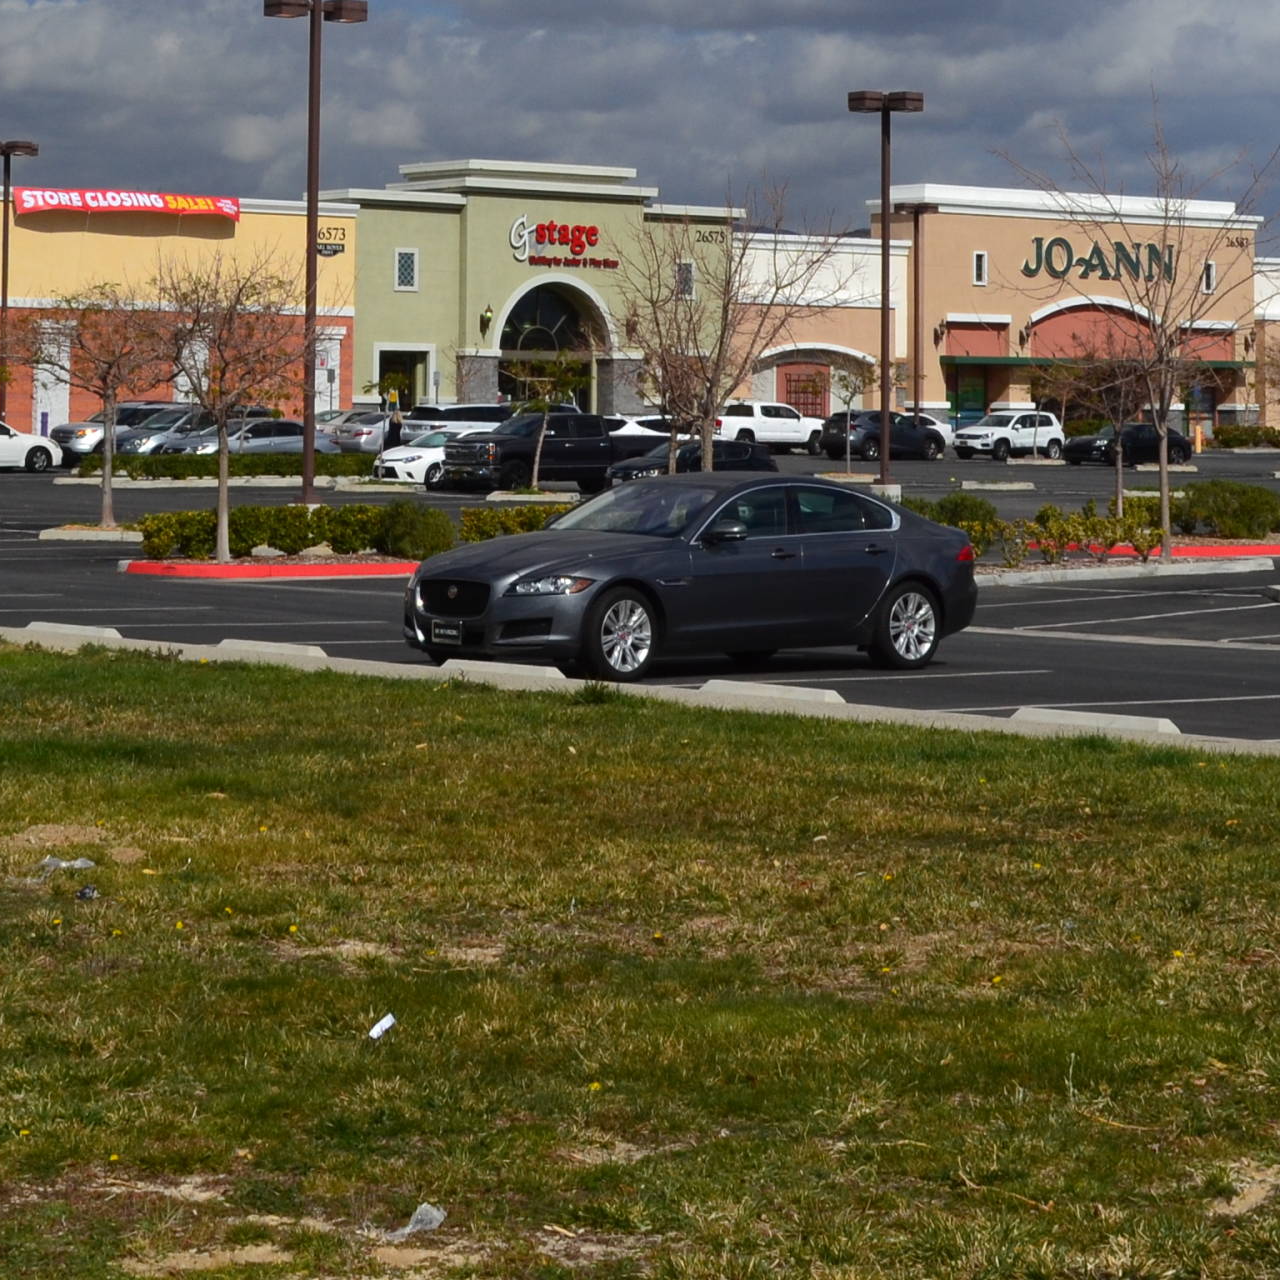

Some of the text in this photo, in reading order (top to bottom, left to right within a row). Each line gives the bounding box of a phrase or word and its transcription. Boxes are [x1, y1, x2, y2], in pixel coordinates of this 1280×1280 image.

[22, 190, 82, 208] STORE
[84, 191, 163, 208] CLOSING
[165, 195, 215, 210] SALE!
[317, 227, 346, 241] 6573
[695, 230, 726, 244] 26575
